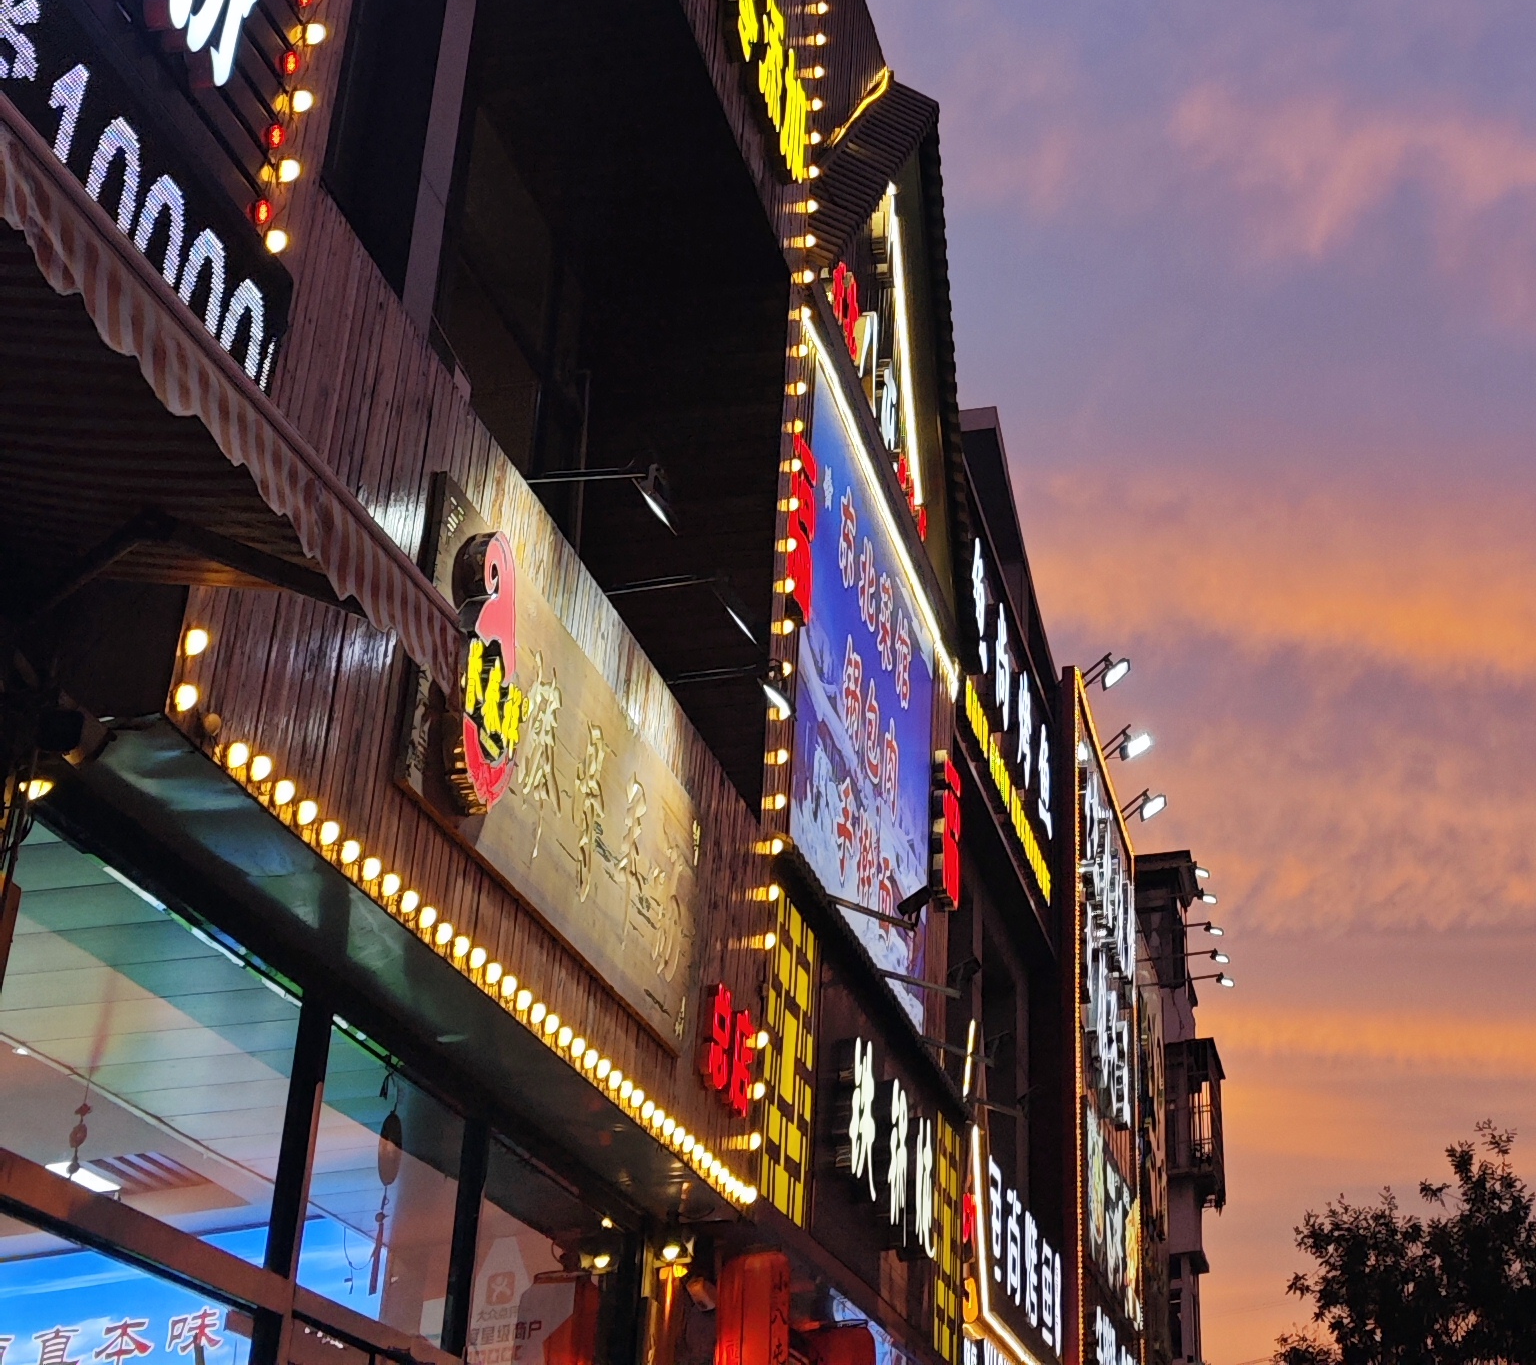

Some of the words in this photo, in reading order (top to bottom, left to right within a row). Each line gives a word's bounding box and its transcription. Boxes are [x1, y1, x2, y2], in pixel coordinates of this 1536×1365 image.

[838, 485, 911, 710] 东北菜馆
[843, 633, 899, 821] 锅包肉
[836, 776, 893, 952] 手擀面
[848, 1036, 937, 1259] 铁锅炖
